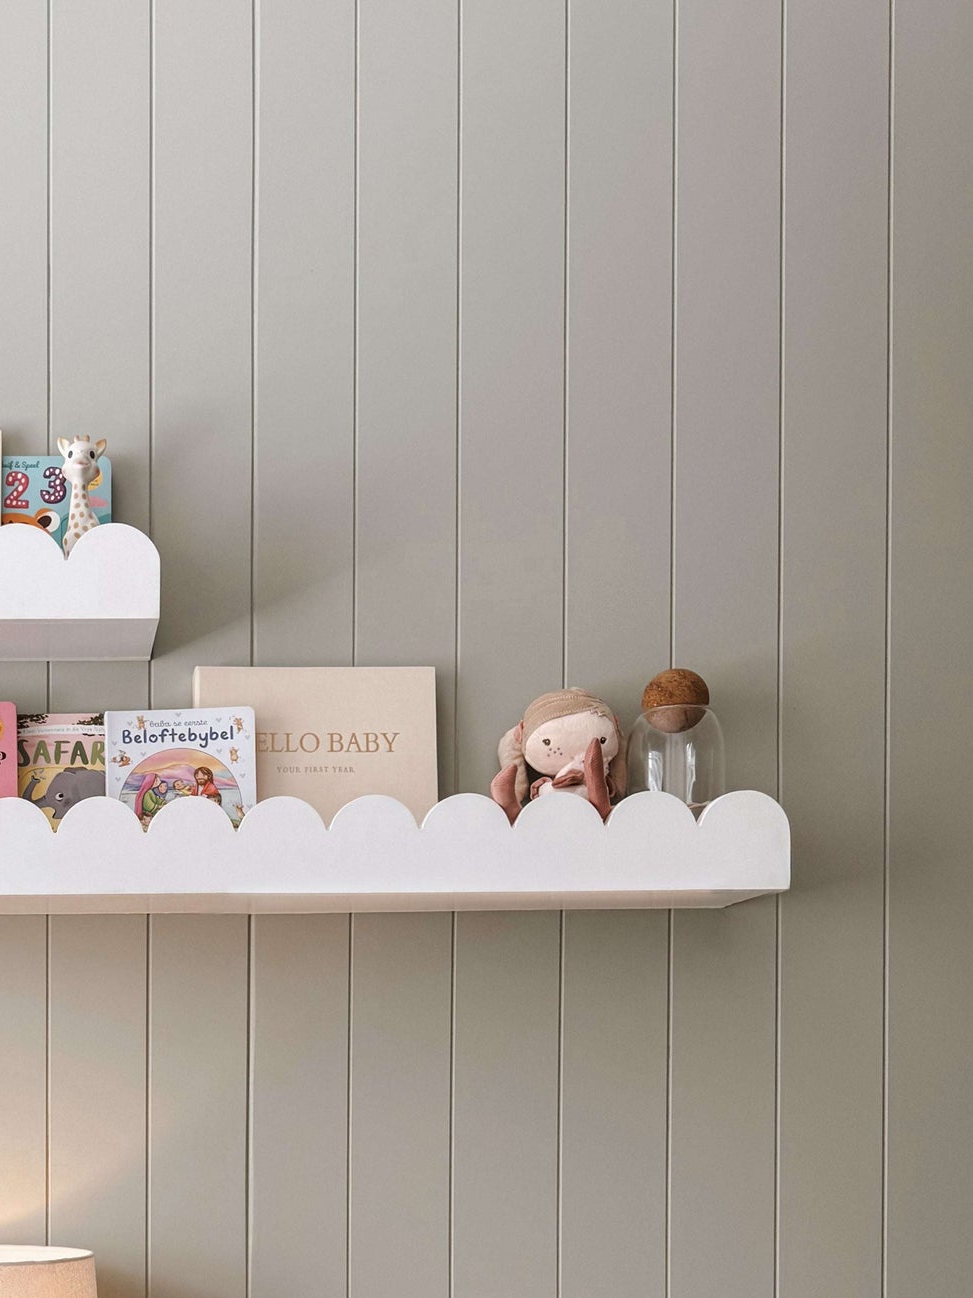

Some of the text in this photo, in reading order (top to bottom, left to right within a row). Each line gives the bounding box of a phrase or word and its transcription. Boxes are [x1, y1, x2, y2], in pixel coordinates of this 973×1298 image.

[4, 466, 67, 509] 2 3
[122, 725, 234, 748] Beloftebybel
[327, 732, 400, 752] BABY
[277, 766, 302, 774] YOUR
